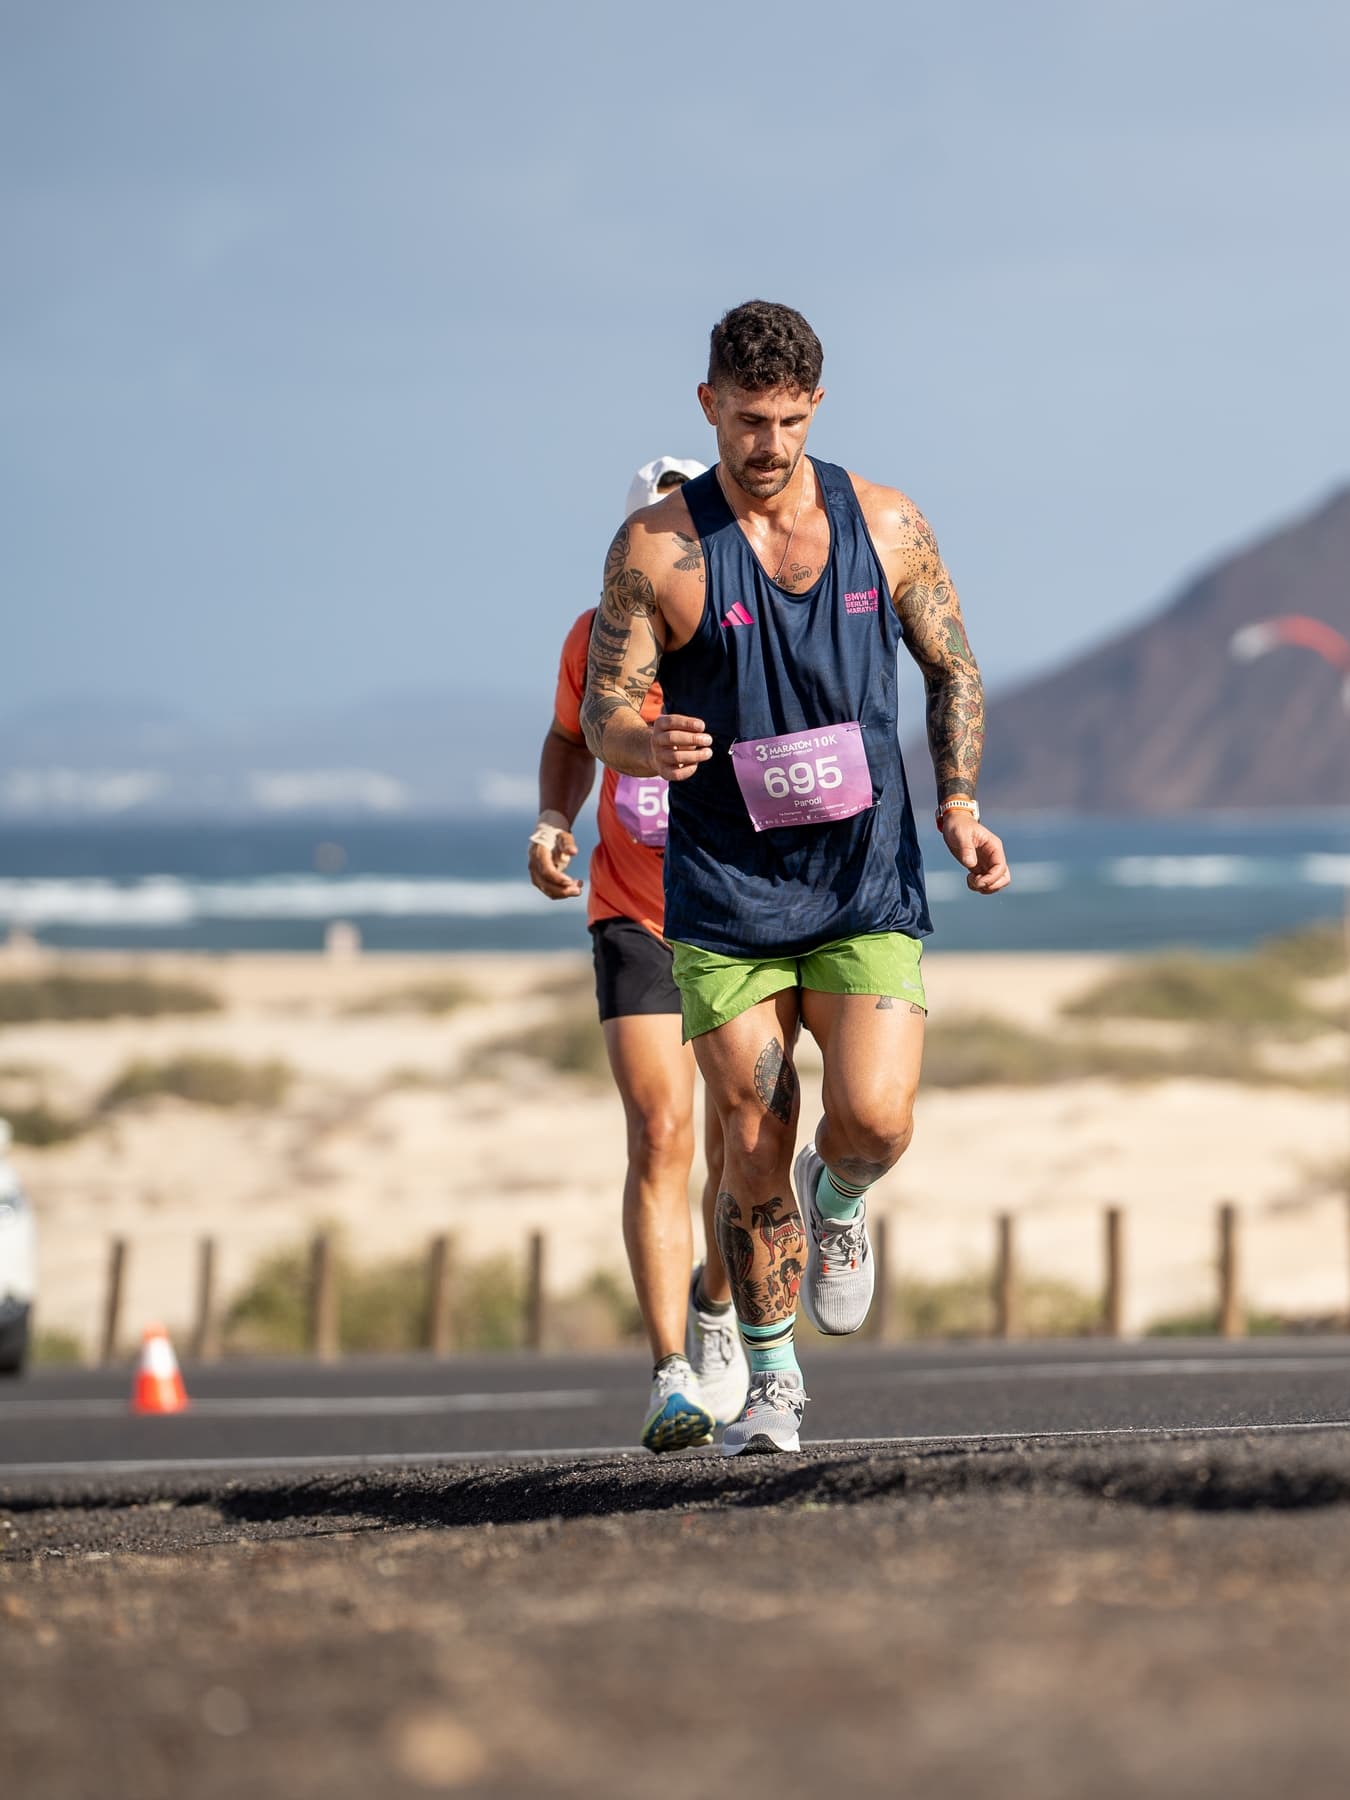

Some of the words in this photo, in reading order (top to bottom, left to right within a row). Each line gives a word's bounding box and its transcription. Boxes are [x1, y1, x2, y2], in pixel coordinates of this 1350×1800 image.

[844, 592, 867, 602] BMW
[846, 600, 869, 608] BERLIN
[814, 735, 838, 748] 10K
[763, 755, 843, 799] 695
[794, 797, 822, 807] Parodi
